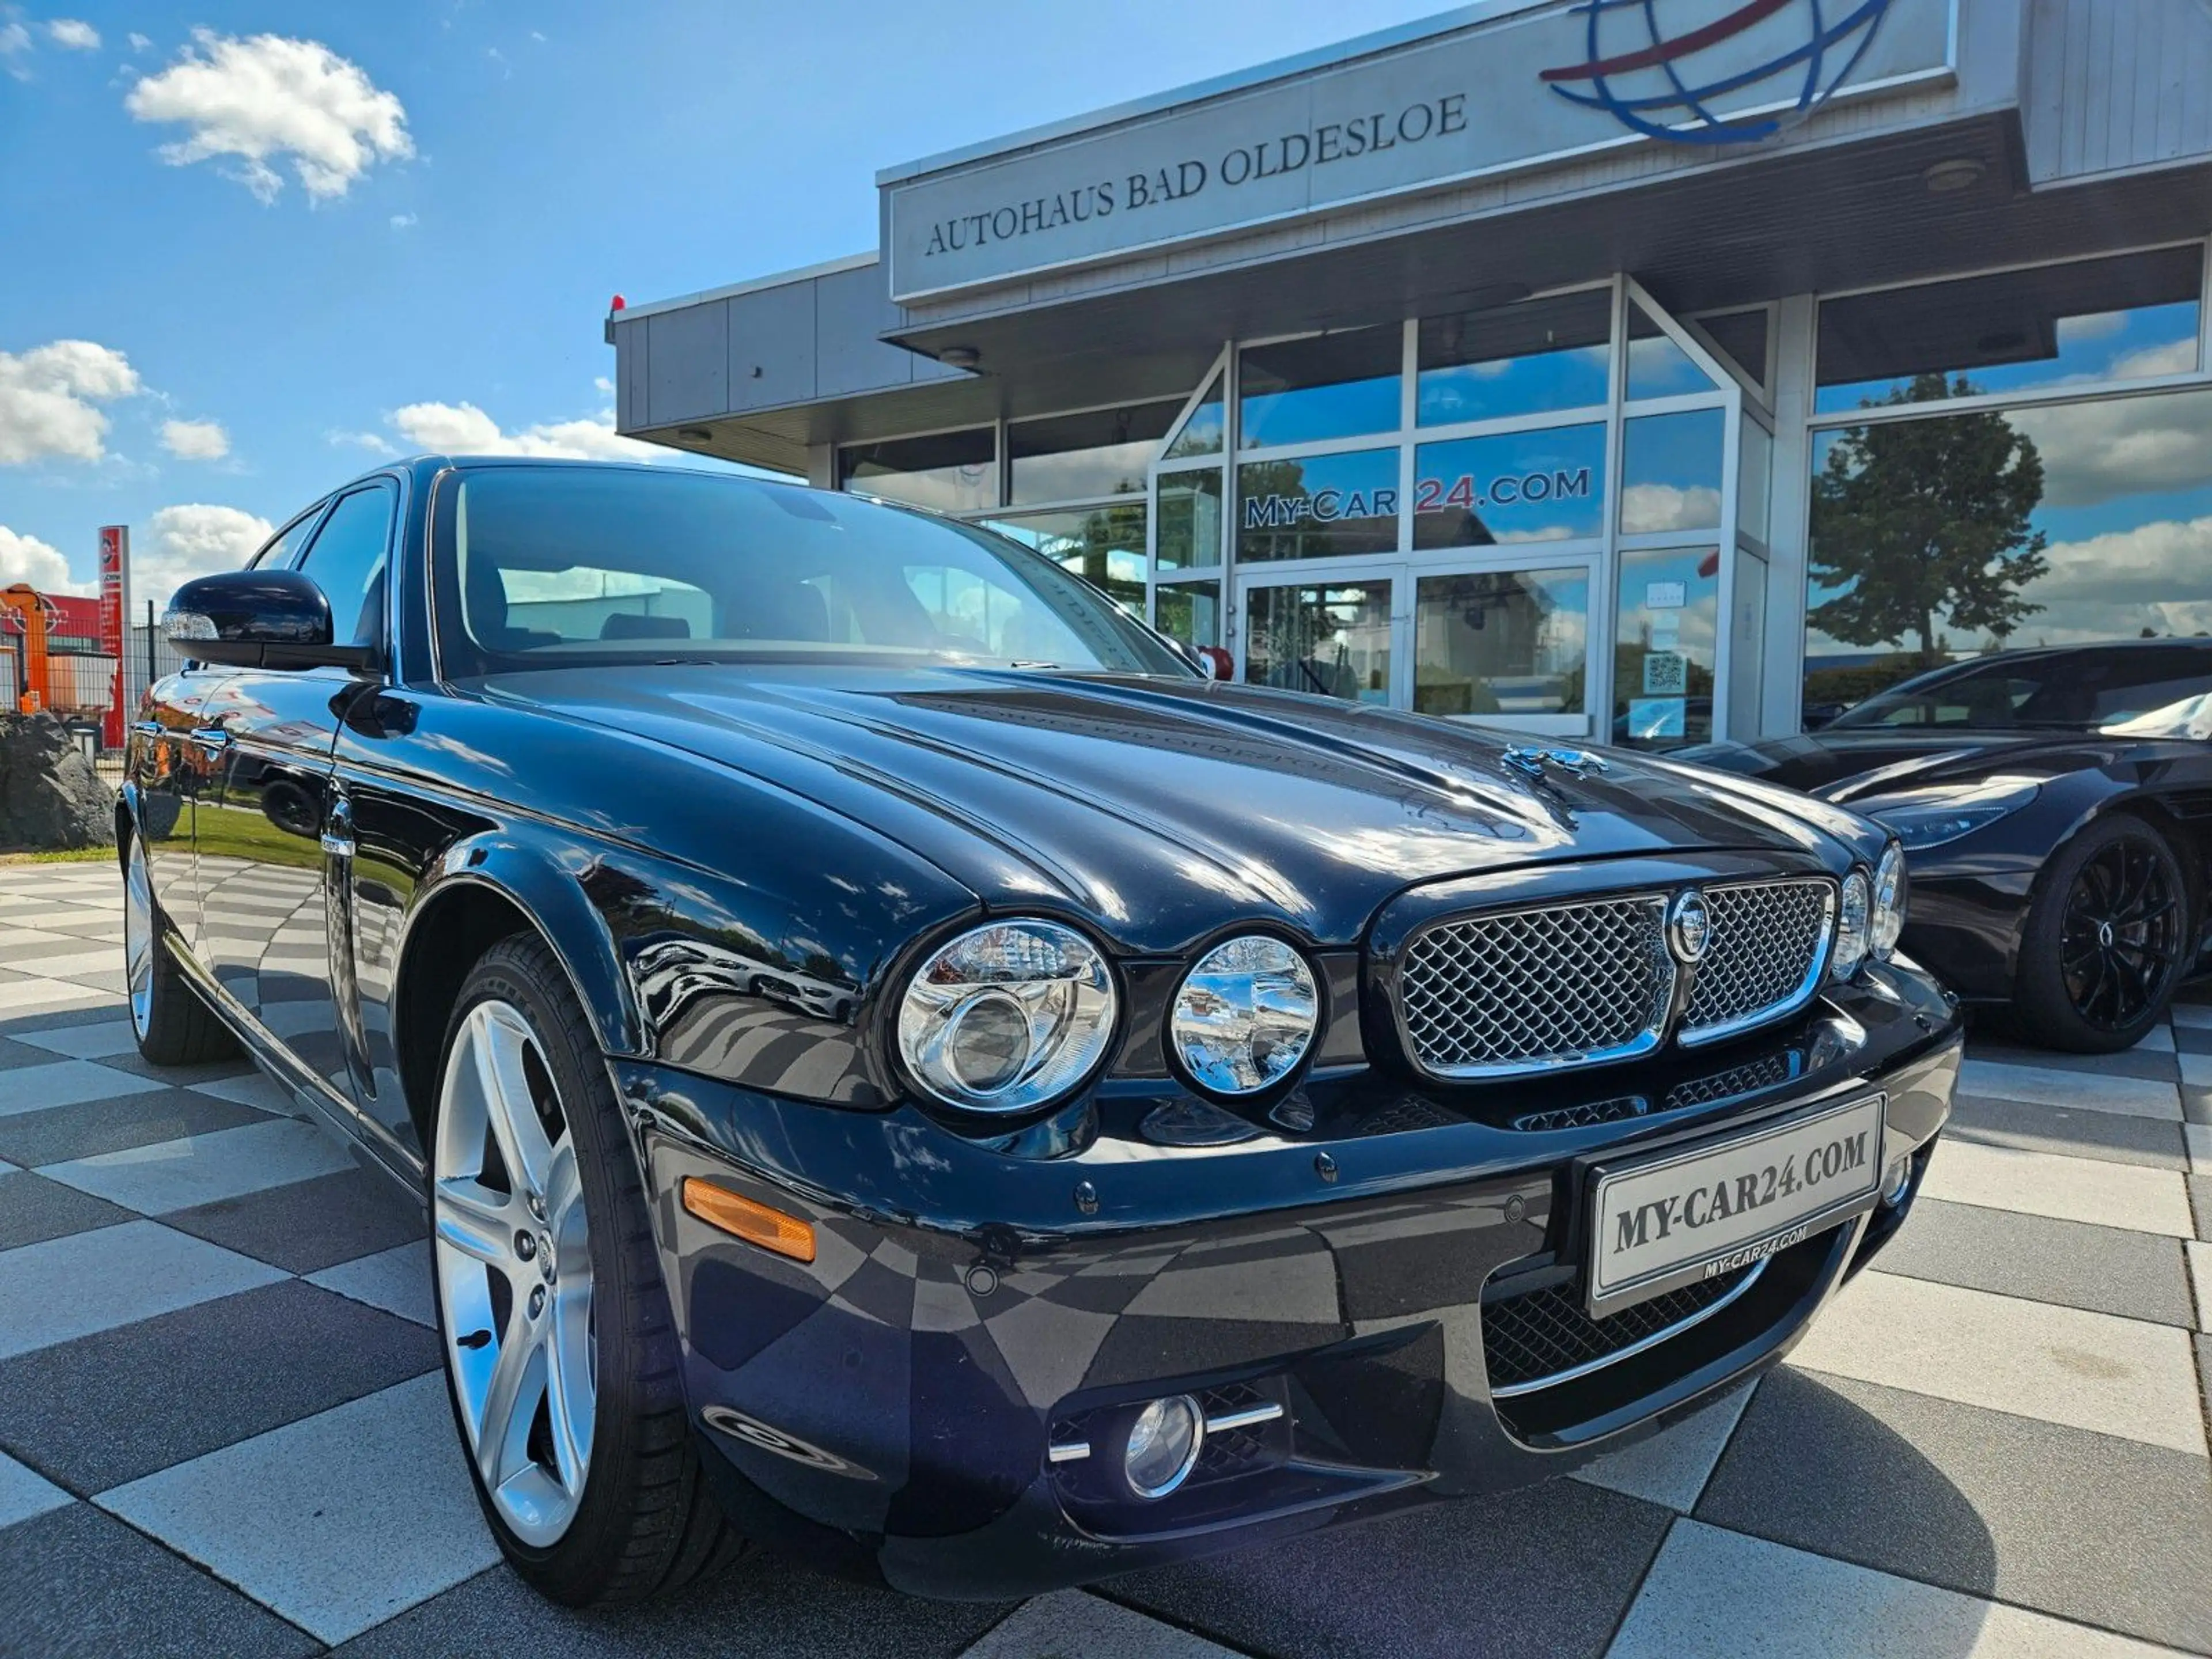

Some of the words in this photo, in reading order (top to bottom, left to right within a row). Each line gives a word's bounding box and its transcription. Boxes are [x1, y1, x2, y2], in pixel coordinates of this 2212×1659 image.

[925, 181, 1115, 256] AUTOHAUS
[1126, 161, 1207, 210] BAD
[1221, 93, 1468, 185] OLDESLOE
[1613, 1131, 1868, 1254] MY-CAR24.COM
[1704, 1226, 1808, 1278] MY-CAR24.COM
